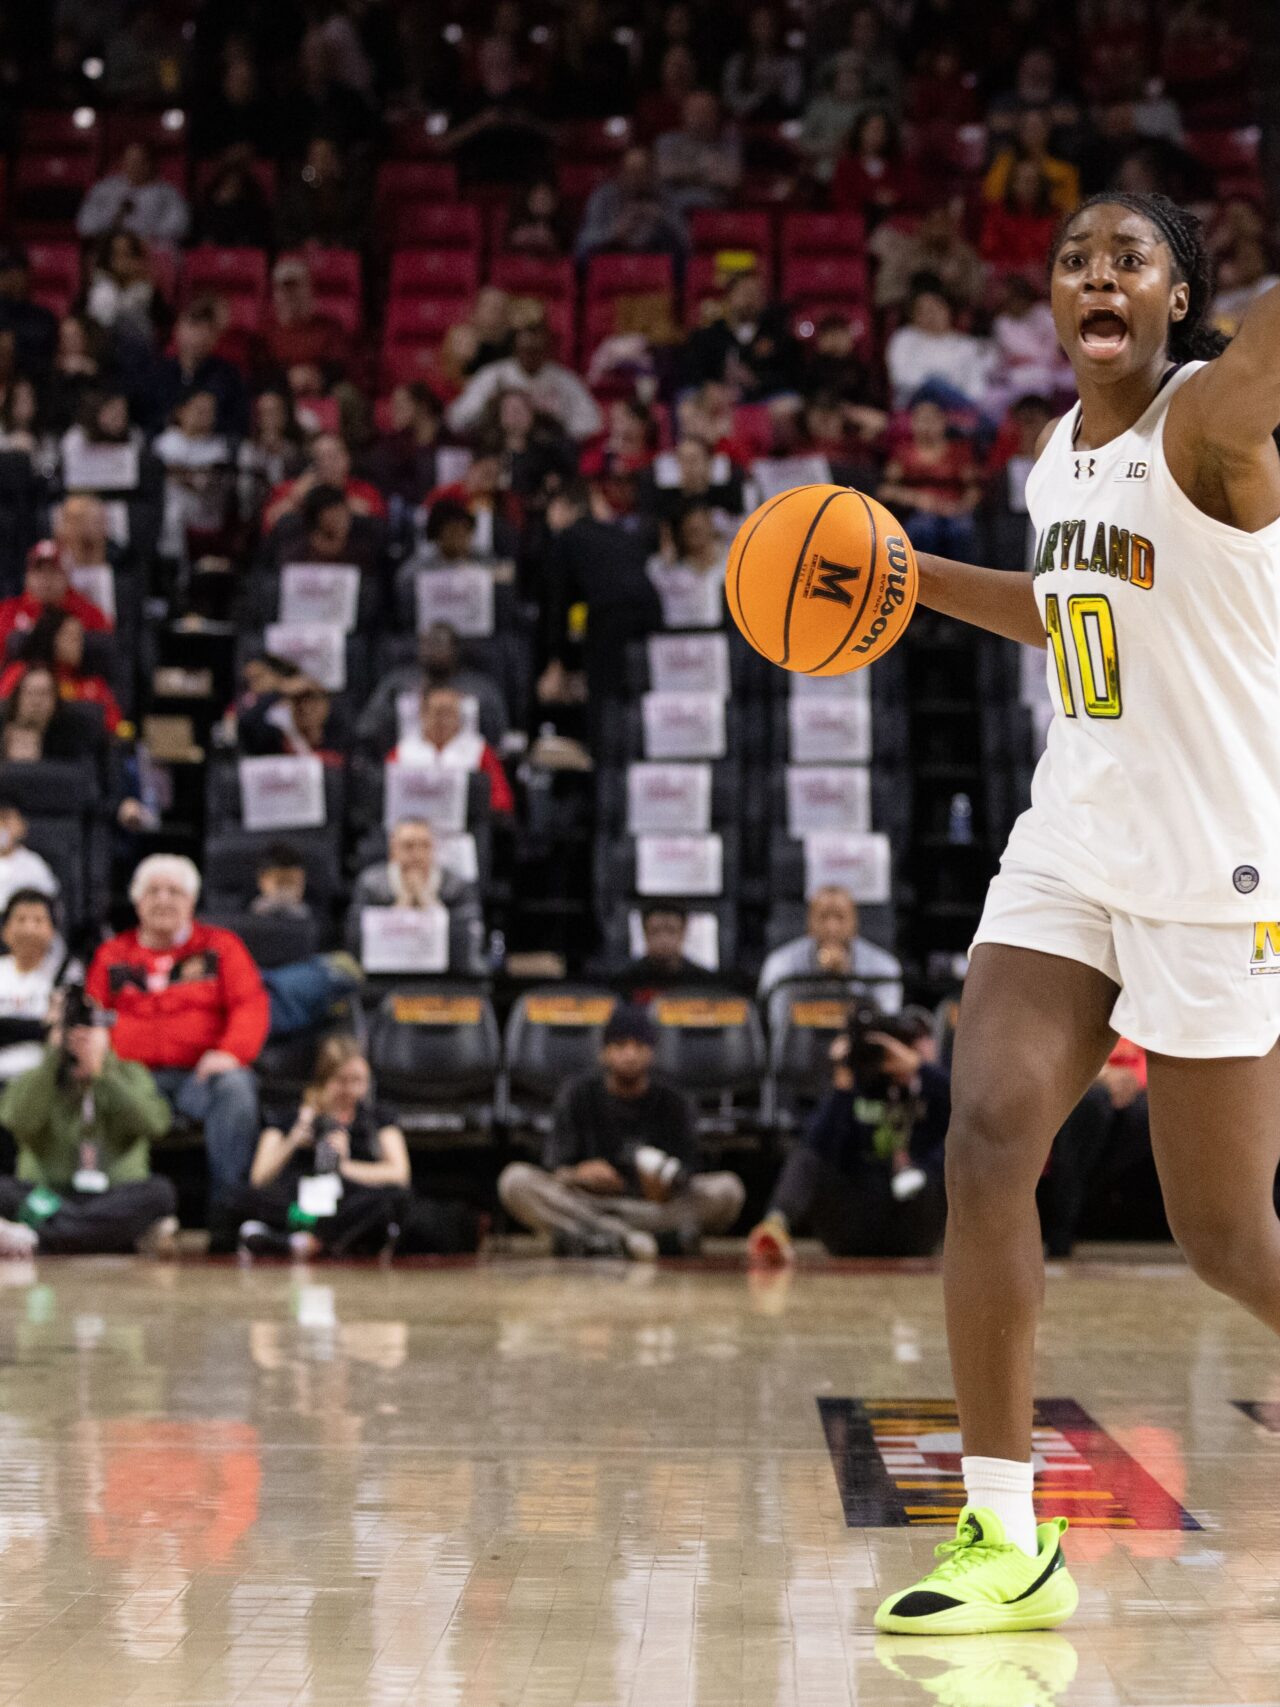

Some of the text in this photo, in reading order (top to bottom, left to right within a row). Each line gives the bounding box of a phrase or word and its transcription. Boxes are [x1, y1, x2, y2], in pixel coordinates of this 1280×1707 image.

[808, 555, 862, 609] M
[851, 534, 908, 654] Wilson
[1033, 519, 1155, 590] RYLAND
[1045, 593, 1123, 719] 10
